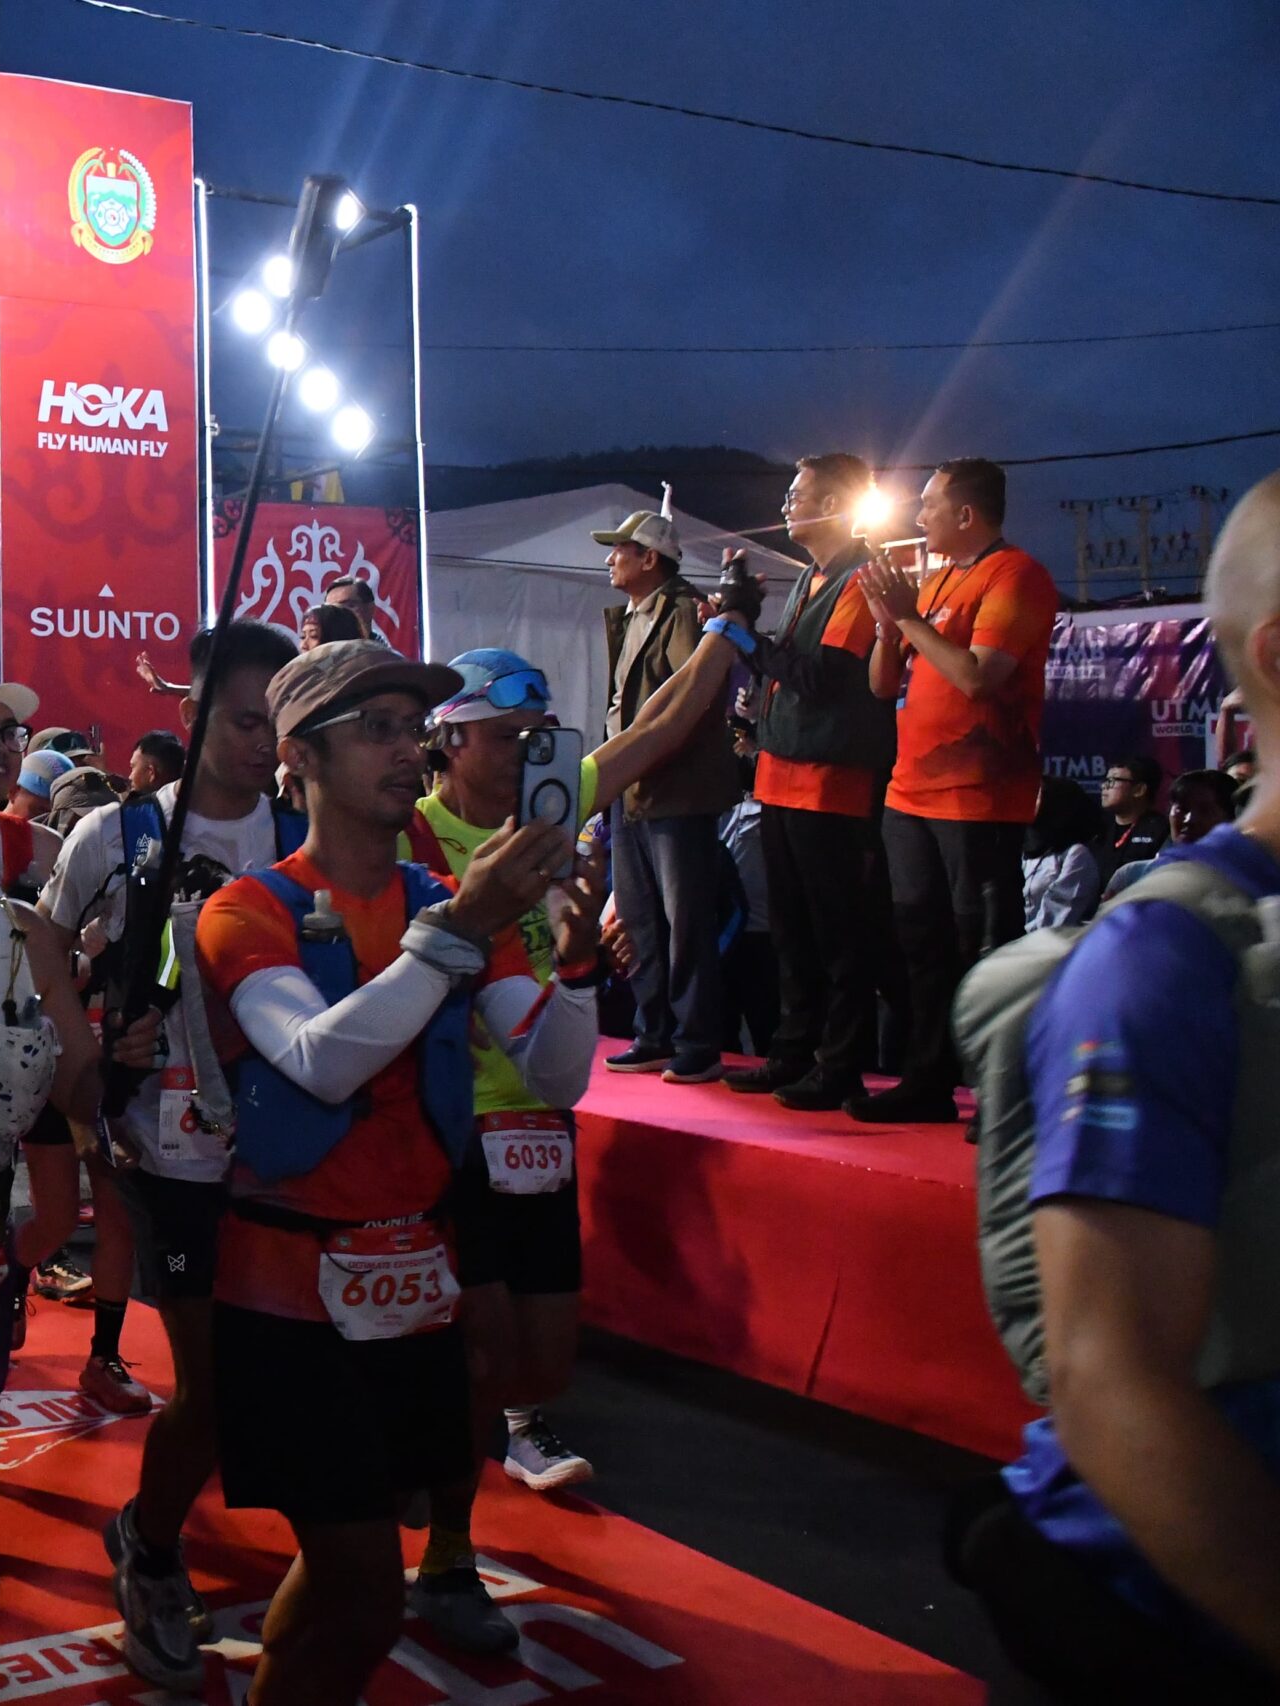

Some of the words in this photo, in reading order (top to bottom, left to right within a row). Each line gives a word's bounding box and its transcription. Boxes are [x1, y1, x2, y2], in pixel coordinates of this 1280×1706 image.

[37, 379, 169, 432] HOKA
[37, 432, 68, 450] FLY
[70, 433, 138, 456] HUMAN
[140, 439, 168, 458] FLY
[30, 606, 180, 641] SUUNTO
[1151, 699, 1214, 722] UTM
[504, 1144, 562, 1170] 6039
[341, 1269, 443, 1307] 6053
